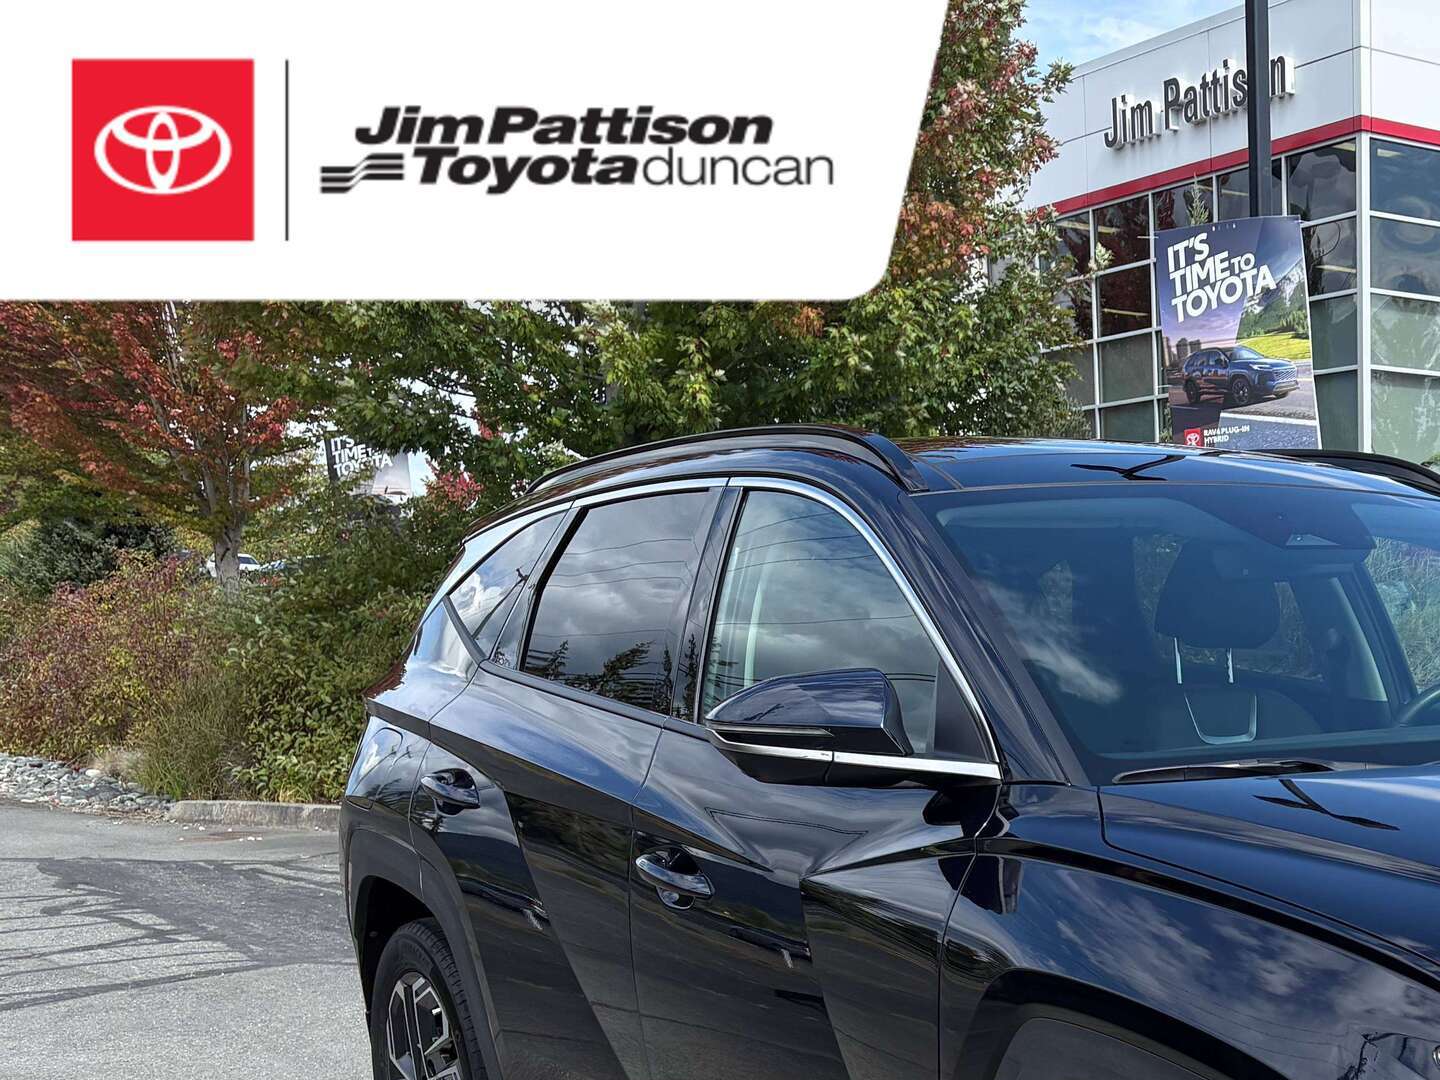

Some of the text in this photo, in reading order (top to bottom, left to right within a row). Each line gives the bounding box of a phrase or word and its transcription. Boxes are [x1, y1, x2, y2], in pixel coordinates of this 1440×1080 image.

[1104, 56, 1290, 149] Jim Pattisn
[1167, 232, 1210, 273] IT'S
[1169, 250, 1256, 297] TIME TO
[1171, 264, 1277, 323] TOYOTA
[331, 434, 355, 452] IT'S
[332, 443, 366, 464] TIME
